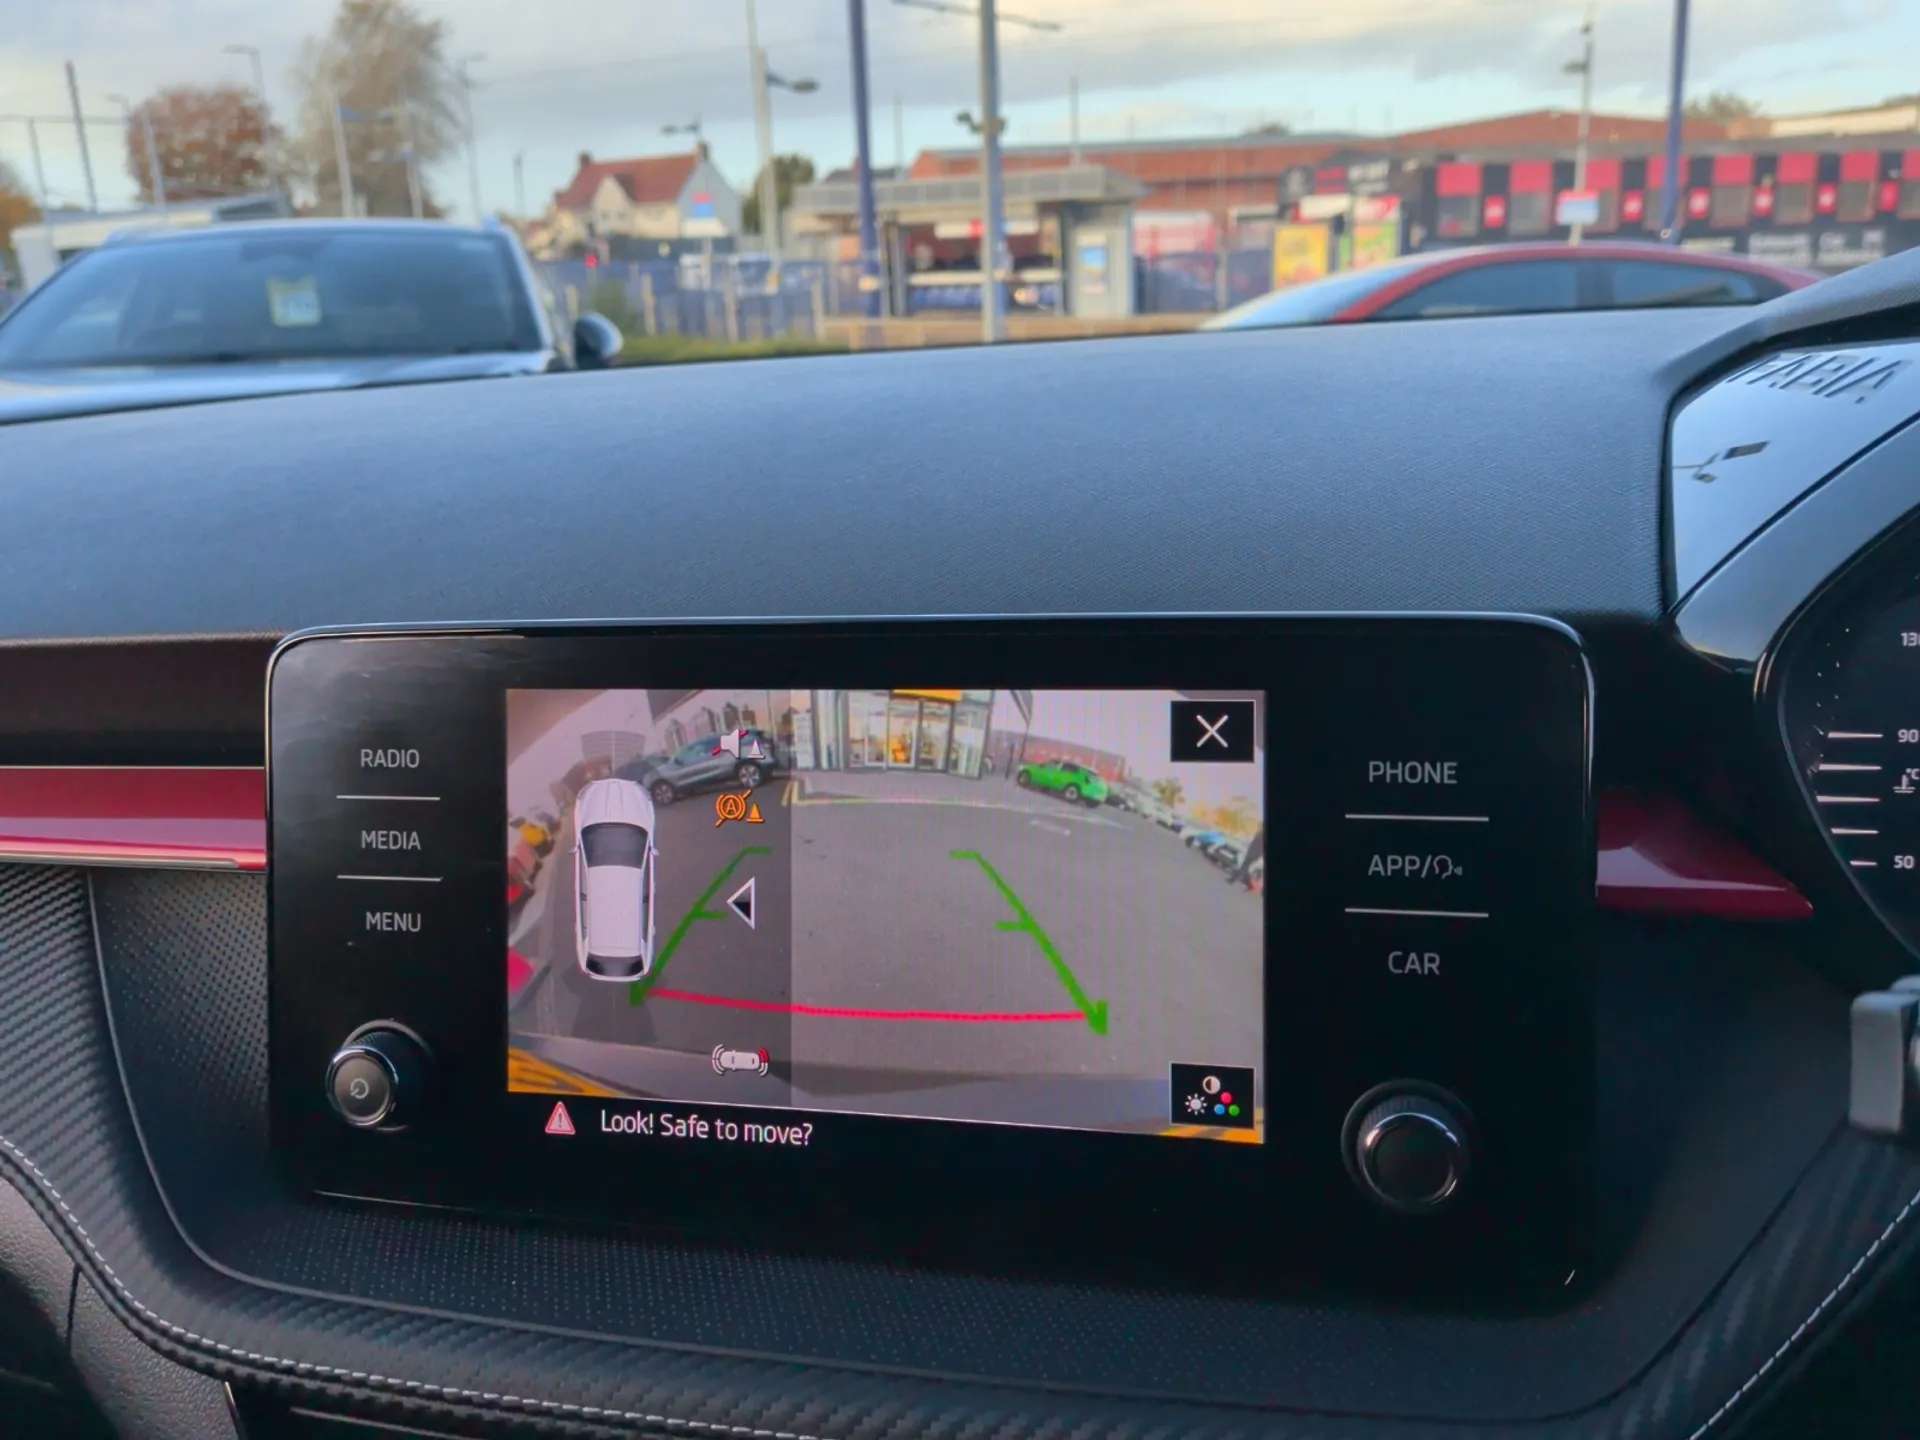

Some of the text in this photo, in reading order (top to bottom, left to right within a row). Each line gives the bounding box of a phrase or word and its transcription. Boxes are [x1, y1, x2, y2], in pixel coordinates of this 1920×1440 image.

[1897, 729, 1919, 743] 90
[360, 748, 420, 769] RADIO
[1368, 760, 1458, 785] PHONE
[361, 829, 422, 851] MEDIA
[1893, 856, 1915, 870] 50
[365, 911, 421, 933] MENU
[1387, 951, 1441, 975] CAR
[600, 1109, 814, 1146] Look! Safe to move?
